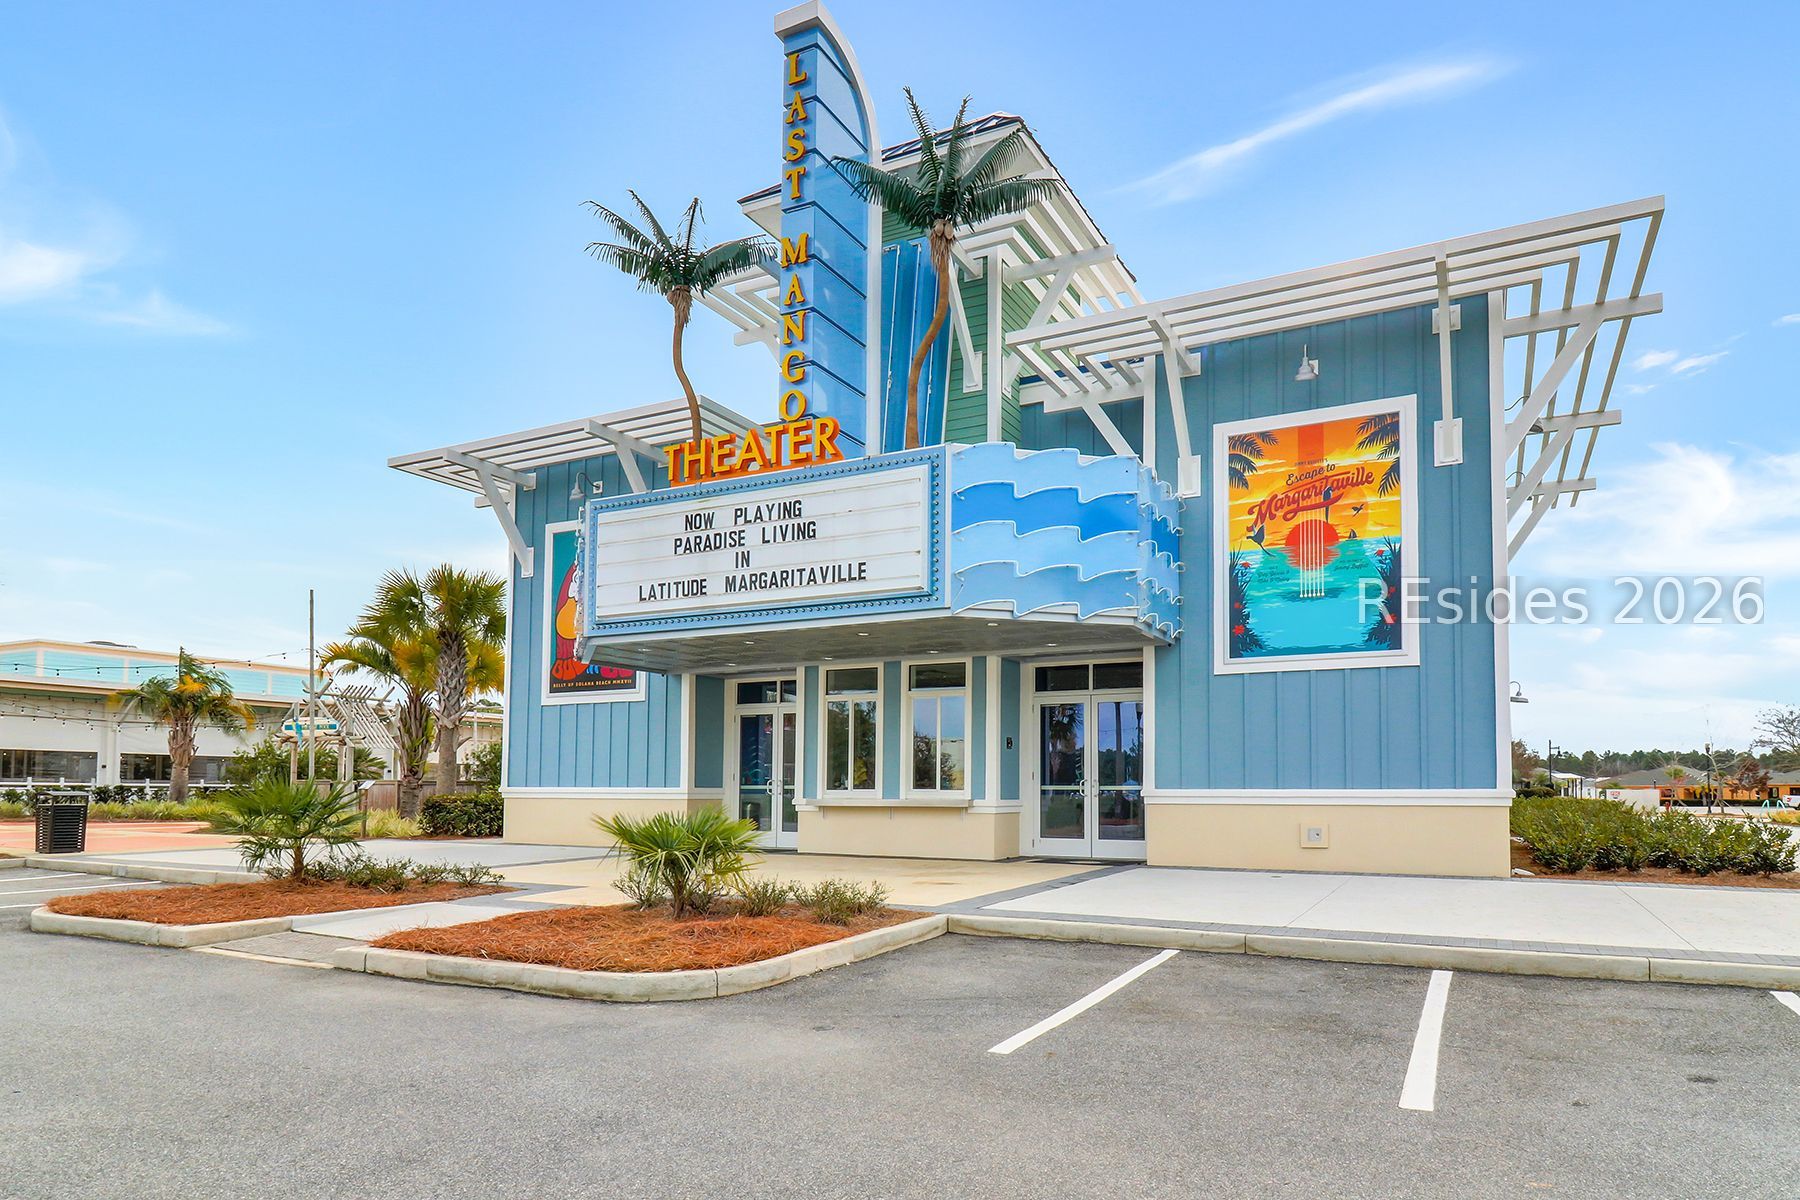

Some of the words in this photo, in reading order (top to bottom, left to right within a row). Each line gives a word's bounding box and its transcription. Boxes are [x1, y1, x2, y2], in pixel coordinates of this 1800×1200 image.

[784, 52, 808, 200] LAST
[780, 231, 808, 421] MANGO
[663, 417, 845, 488] THEATER
[1286, 467, 1325, 486] Escape
[1326, 463, 1336, 473] to
[684, 511, 715, 532] NOW
[734, 499, 802, 526] PLAYING
[674, 529, 746, 555] PARADISE
[761, 520, 817, 545] LIVING
[735, 550, 750, 569] IN
[638, 578, 707, 602] LATITUDE
[725, 561, 867, 594] MARGARITAVILLE
